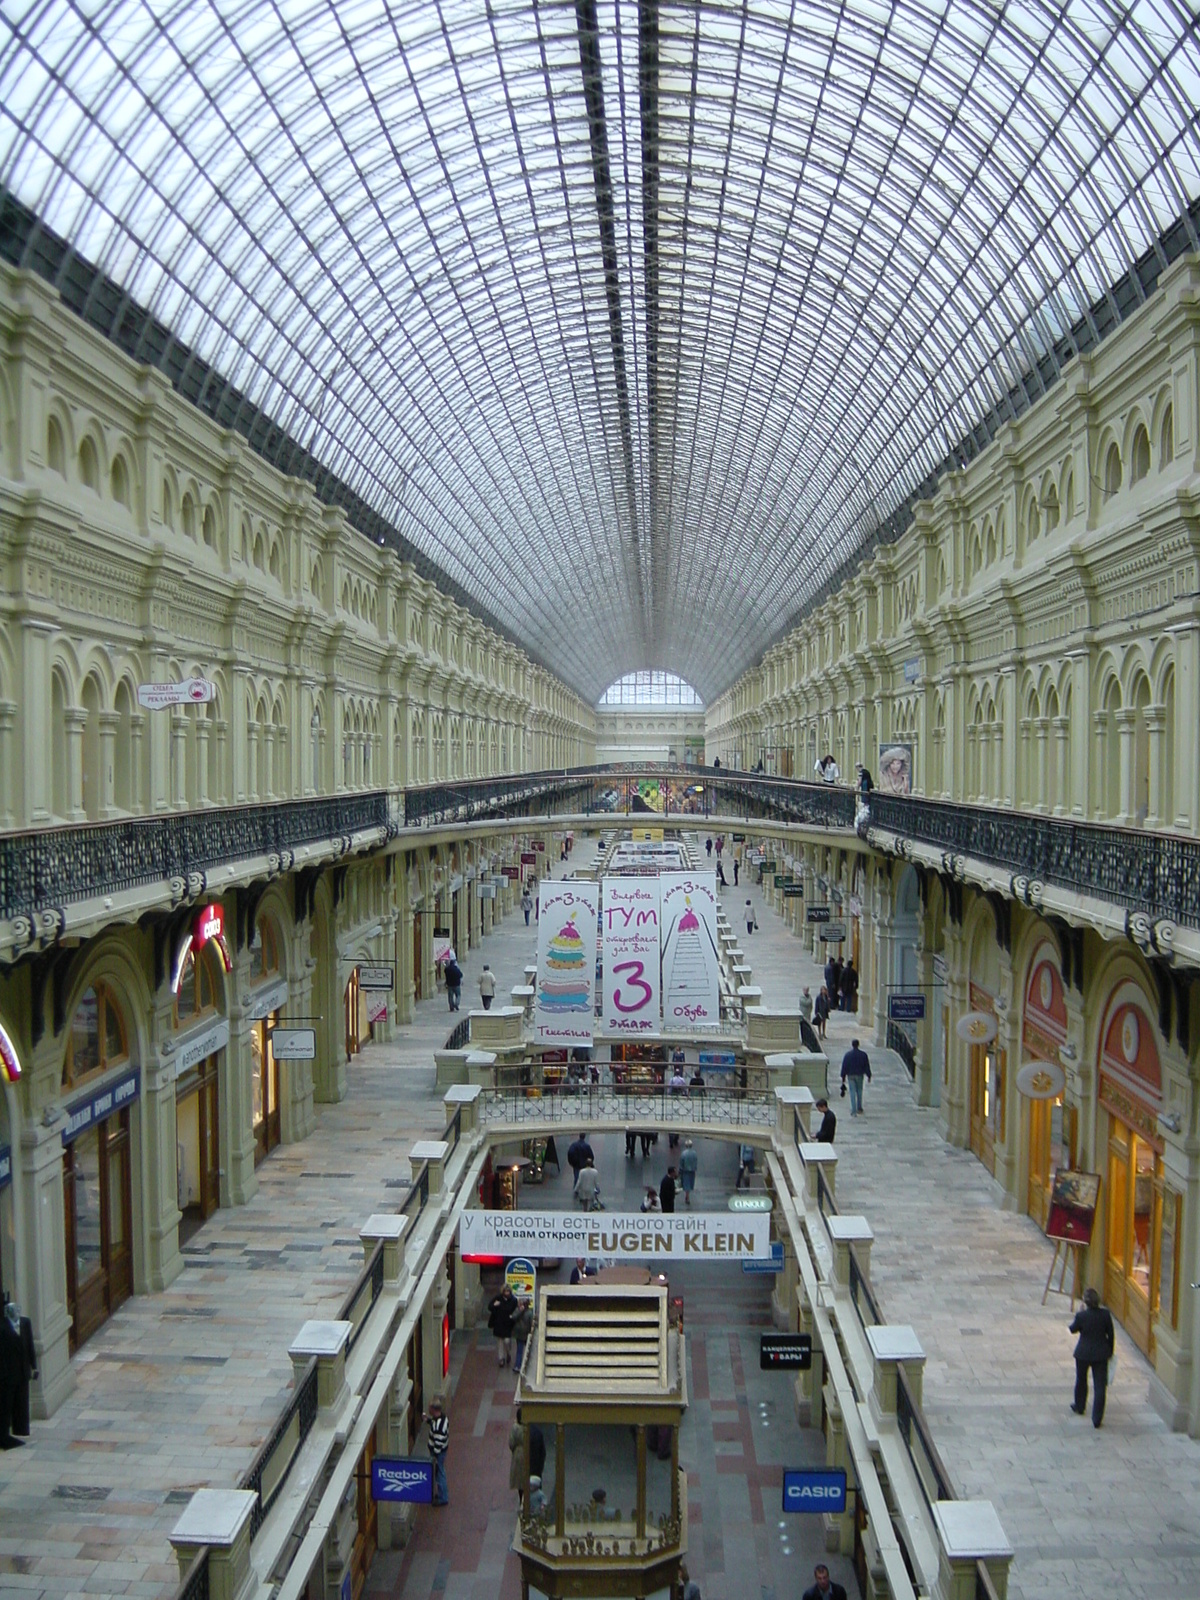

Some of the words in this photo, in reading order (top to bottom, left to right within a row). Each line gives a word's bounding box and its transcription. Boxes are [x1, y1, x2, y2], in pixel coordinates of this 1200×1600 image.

[683, 881, 694, 894] 3
[563, 892, 575, 906] 3
[612, 961, 652, 1013] 3
[673, 1005, 708, 1022] Обувь
[609, 1019, 653, 1029] этаж
[536, 1025, 591, 1038] Текстиль
[734, 1200, 766, 1209] CLINIQUE
[464, 1215, 474, 1230] у
[484, 1215, 555, 1230] красоты
[562, 1217, 601, 1229] есть
[612, 1218, 664, 1230] много
[667, 1216, 707, 1231] тайн
[495, 1229, 510, 1238] их
[512, 1230, 536, 1239] вам
[538, 1231, 588, 1242] откроет
[588, 1233, 672, 1252] EUGEN
[684, 1233, 755, 1252] KLEIN
[769, 1353, 803, 1361] ТОВАРЫ
[378, 1468, 428, 1480] Reebok
[788, 1486, 842, 1498] CASIO
